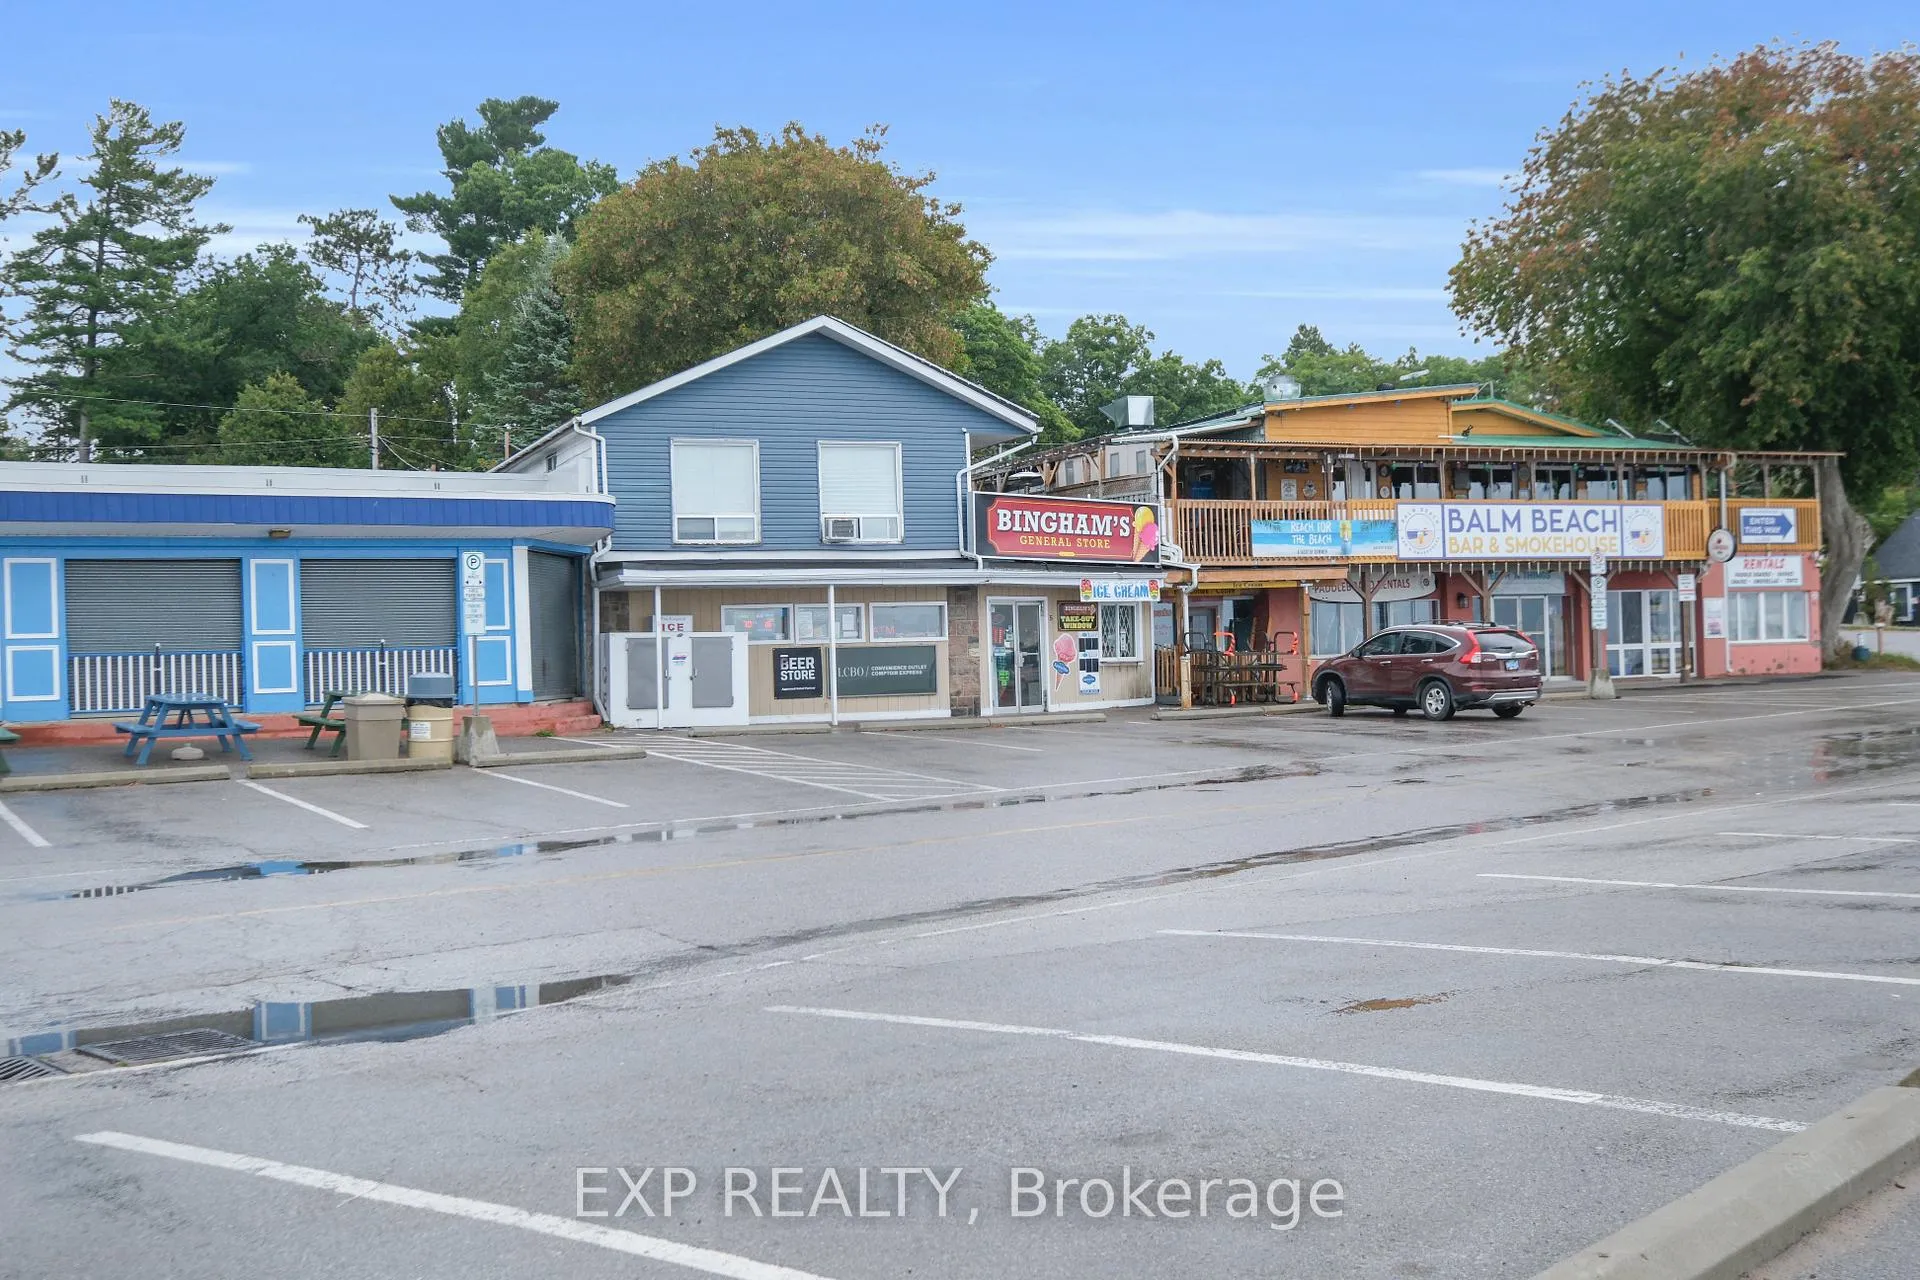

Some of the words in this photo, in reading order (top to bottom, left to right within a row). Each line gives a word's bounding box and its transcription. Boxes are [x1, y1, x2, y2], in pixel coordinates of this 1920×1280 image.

[996, 508, 1131, 537] BINGHAM'S
[1448, 508, 1522, 533] BALM
[1531, 508, 1618, 533] BEACH
[1019, 536, 1072, 547] GENERAL
[1076, 539, 1111, 549] STORE
[1291, 534, 1305, 545] THE
[1308, 533, 1333, 545] BEACH
[1448, 535, 1484, 554] BAR
[1489, 536, 1499, 554] &
[1504, 535, 1618, 554] SMOKEHOUSE
[1743, 558, 1785, 570] RENTALS
[1093, 583, 1111, 598] ICE
[1060, 615, 1095, 623] TAKE-OUT
[661, 623, 684, 632] ICE
[780, 656, 815, 670] BEER
[780, 669, 816, 681] STORE
[837, 666, 865, 678] LCBO
